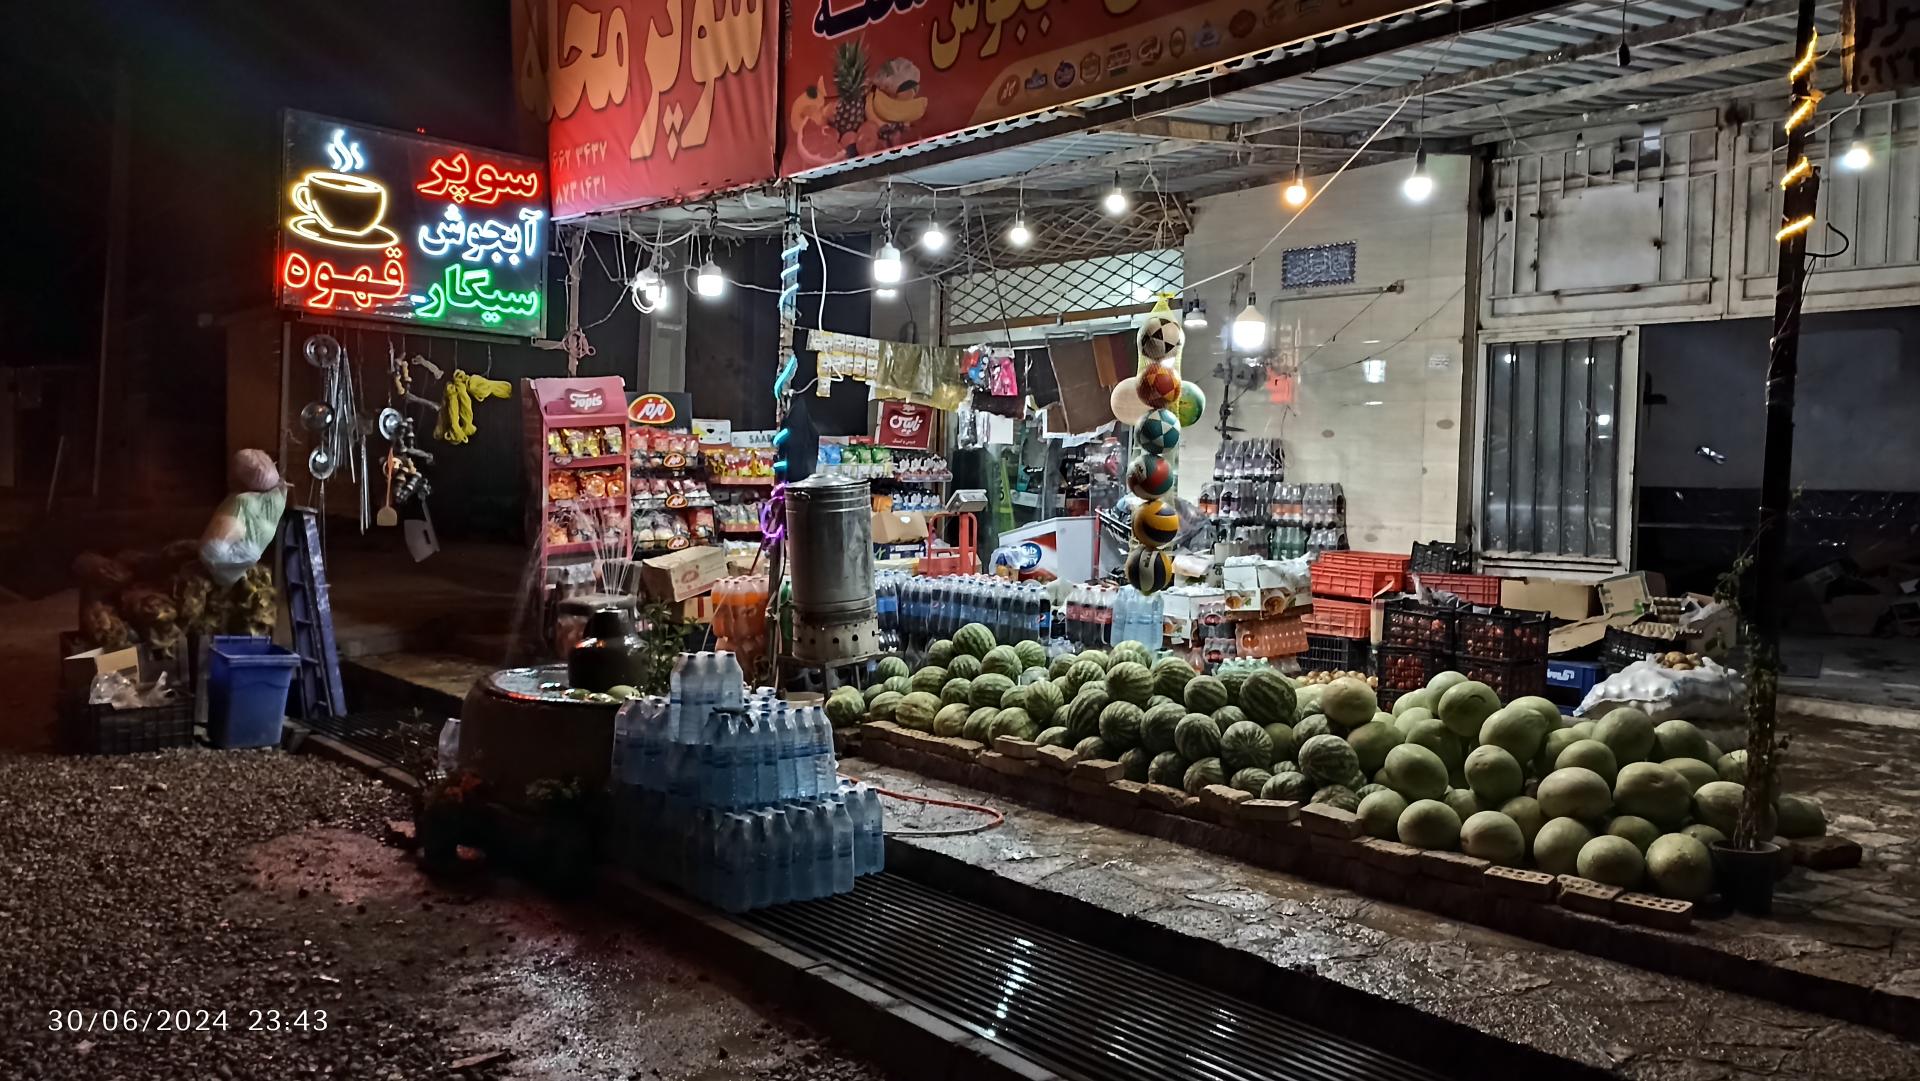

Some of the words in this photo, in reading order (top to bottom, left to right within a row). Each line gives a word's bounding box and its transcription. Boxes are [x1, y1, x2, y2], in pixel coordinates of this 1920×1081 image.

[629, 0, 765, 161] سوپر
[417, 153, 538, 204] سوپر
[417, 203, 544, 265] آبجوش
[284, 247, 404, 308] قهوه
[411, 263, 538, 323] سیگار
[569, 393, 603, 411] Topis
